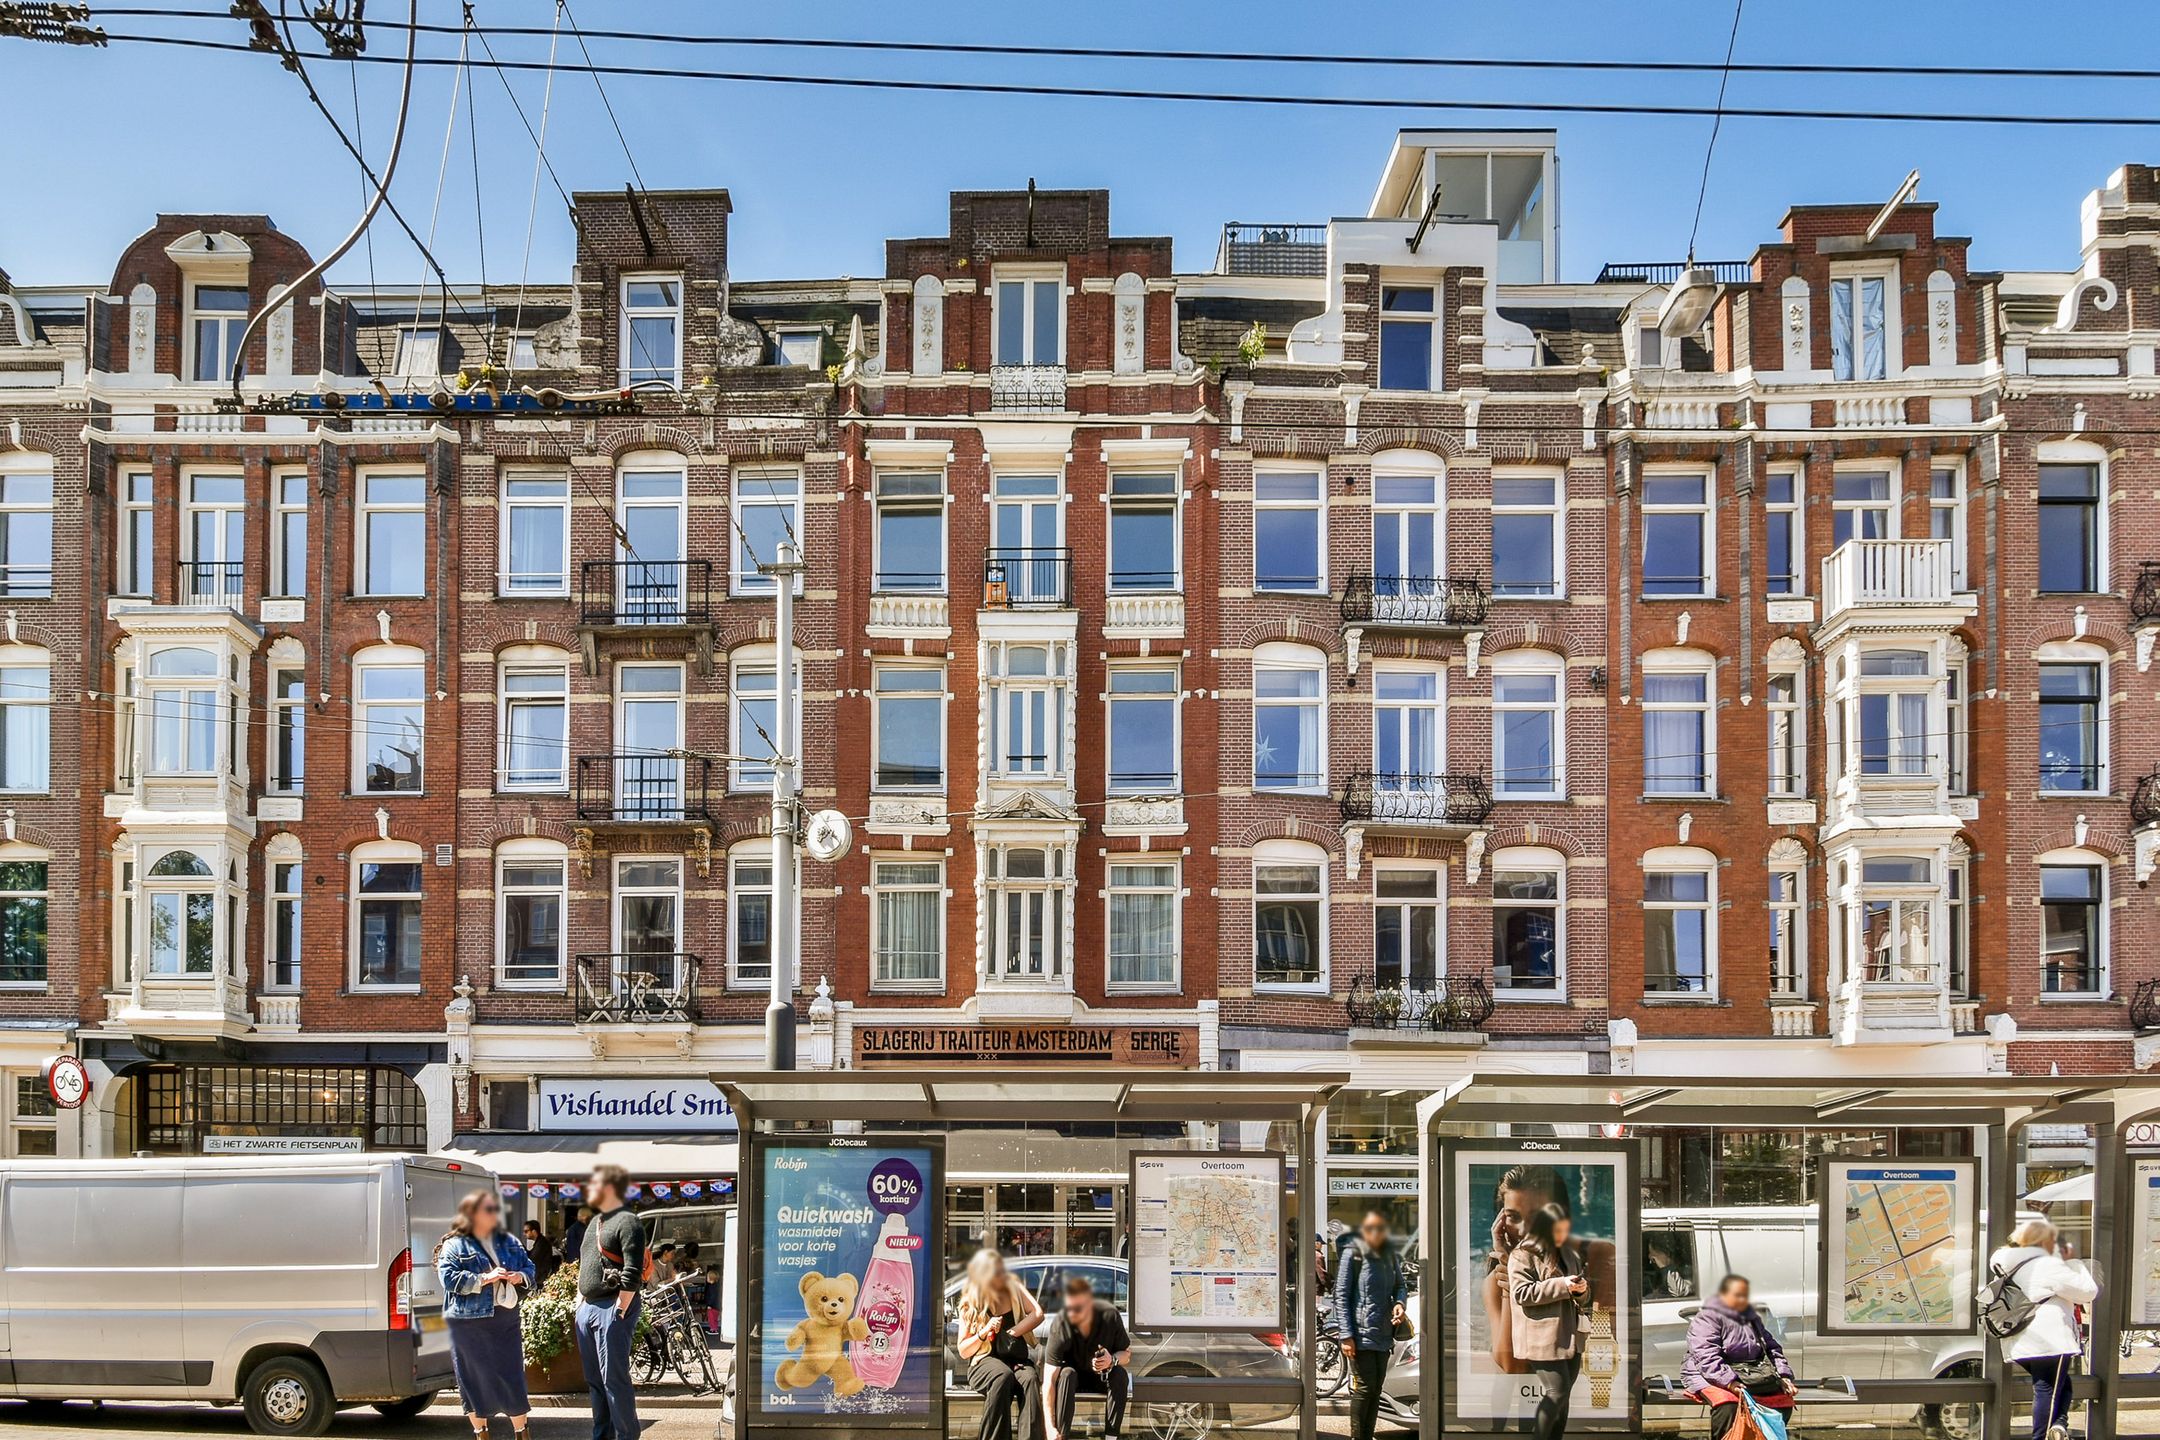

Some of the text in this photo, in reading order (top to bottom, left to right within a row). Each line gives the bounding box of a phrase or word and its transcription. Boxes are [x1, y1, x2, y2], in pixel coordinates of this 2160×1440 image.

[863, 1030, 1112, 1050] SLAGERIJ TRAITEUR AMSTERDAM
[1131, 1031, 1180, 1051] SERGE
[54, 1056, 84, 1071] REPARATIE
[56, 1096, 81, 1108] VERKOOP
[547, 1090, 677, 1116] Vishandel
[223, 1140, 358, 1149] HET ZWARTE FIETSENPLAN
[828, 1138, 868, 1147] JCDecaux
[1520, 1141, 1561, 1150] JCDecaux
[774, 1157, 808, 1172] Robijn
[1201, 1161, 1245, 1170] Overtoom
[1883, 1171, 1920, 1179] Overtoom
[872, 1174, 917, 1195] 60%
[1346, 1182, 1366, 1190] HET
[1369, 1182, 1413, 1190] ZWARTE
[879, 1195, 910, 1205] korting
[777, 1206, 874, 1225] Quickwash
[778, 1226, 842, 1238] wasmiddel
[778, 1241, 836, 1251] voor korte
[889, 1238, 919, 1247] NIEUW
[777, 1255, 817, 1268] wasjes
[869, 1310, 898, 1324] Robijn
[875, 1337, 885, 1347] 15
[769, 1394, 796, 1406] bol.
